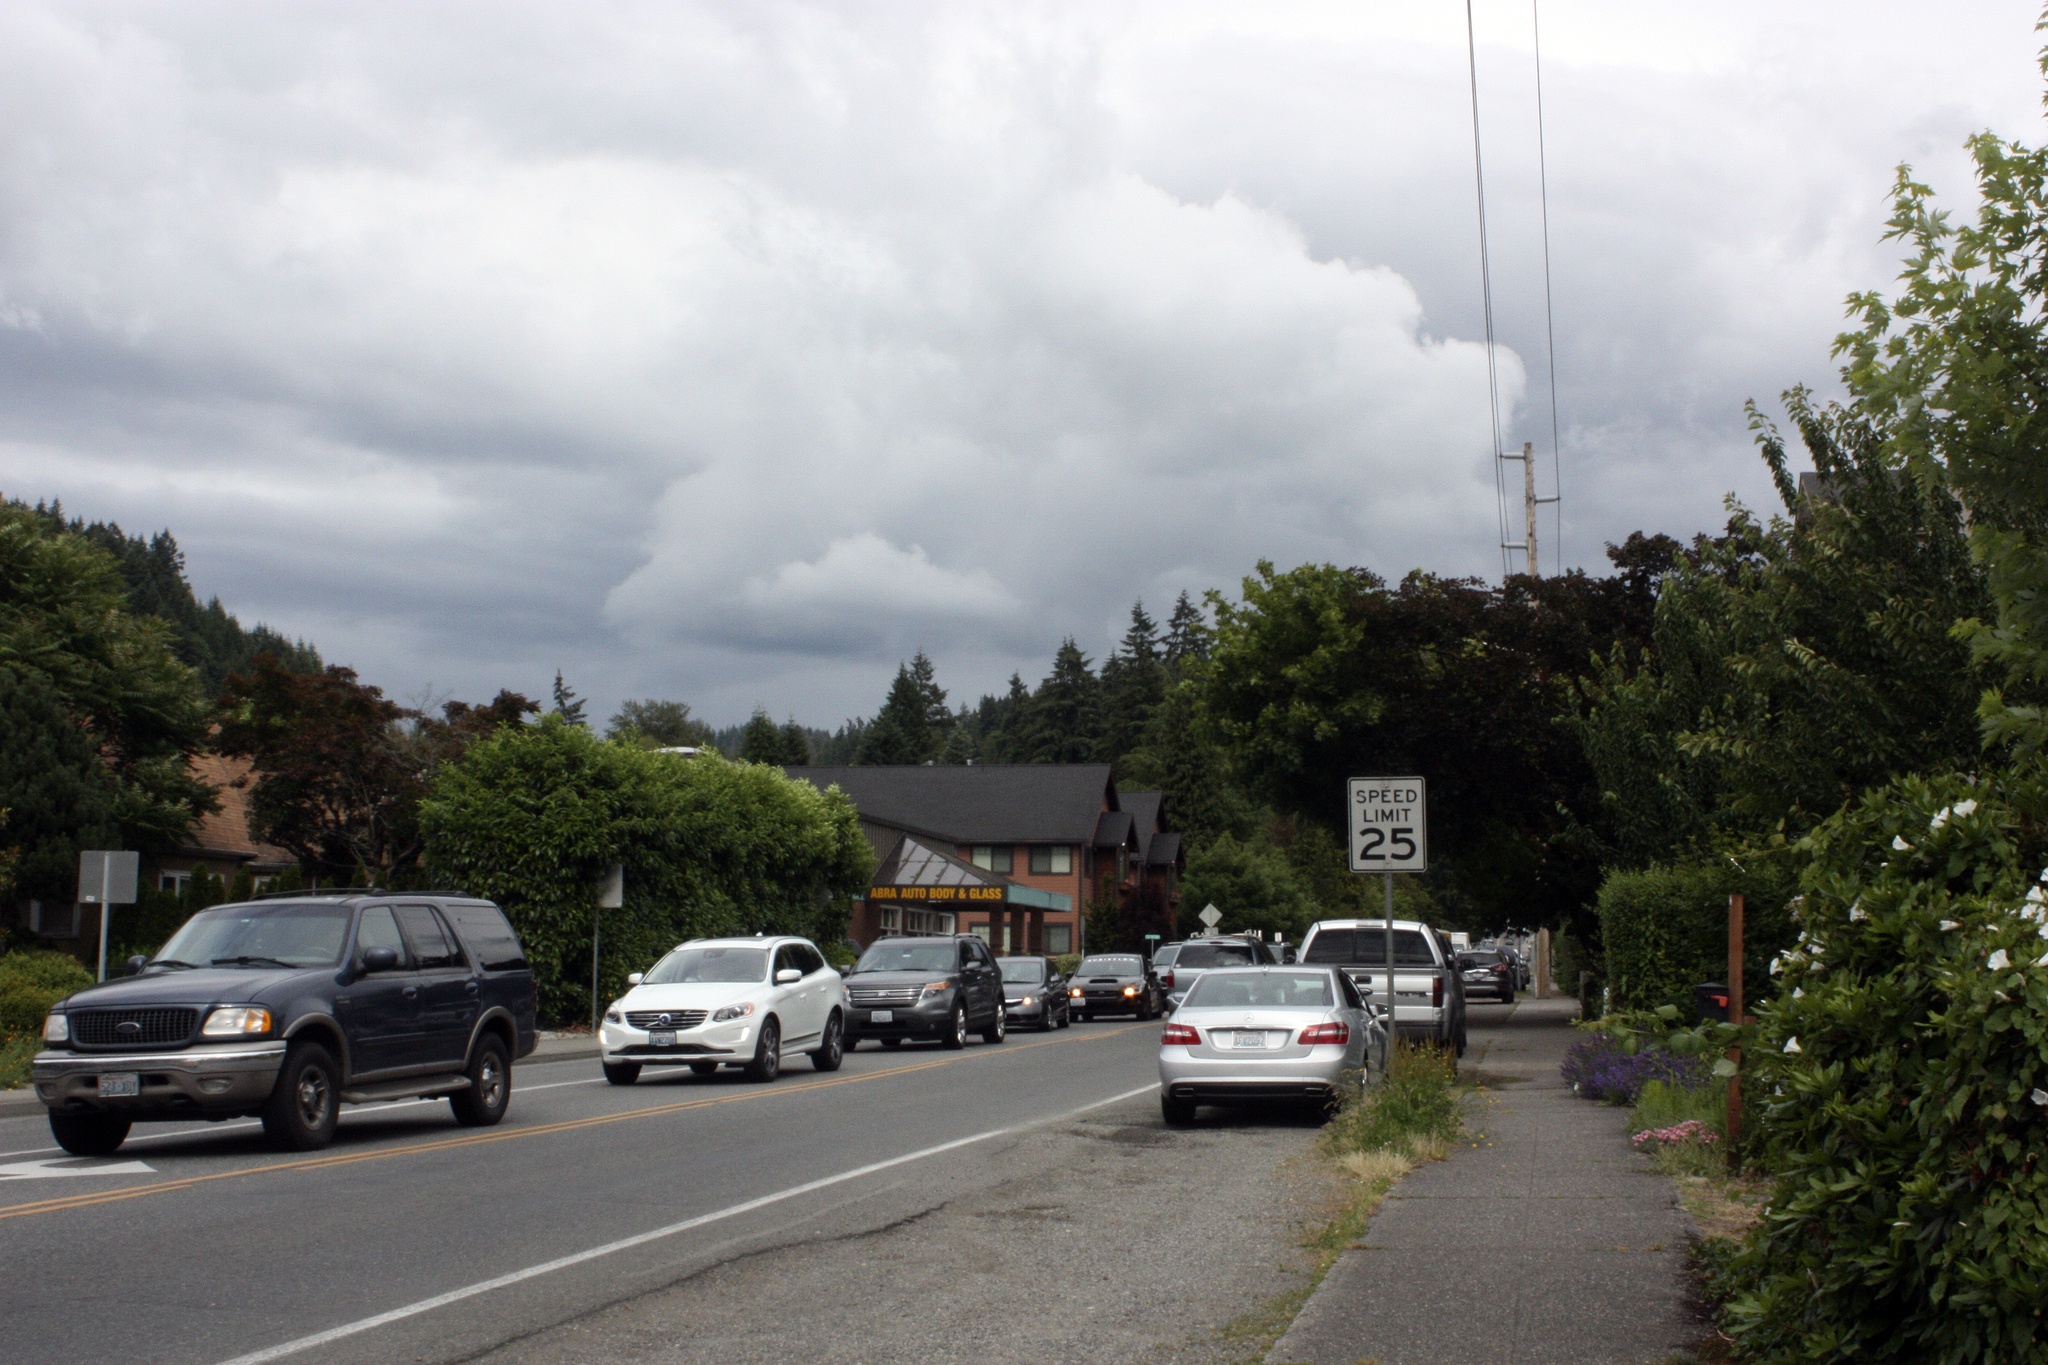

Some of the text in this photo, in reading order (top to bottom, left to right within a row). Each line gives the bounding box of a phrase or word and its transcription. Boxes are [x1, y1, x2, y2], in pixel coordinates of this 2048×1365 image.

[1356, 789, 1417, 804] SPEED
[1363, 808, 1412, 823] LIMIT
[1359, 827, 1417, 861] 25
[870, 887, 1002, 900] ABRA AUTO BODY & GLASS
